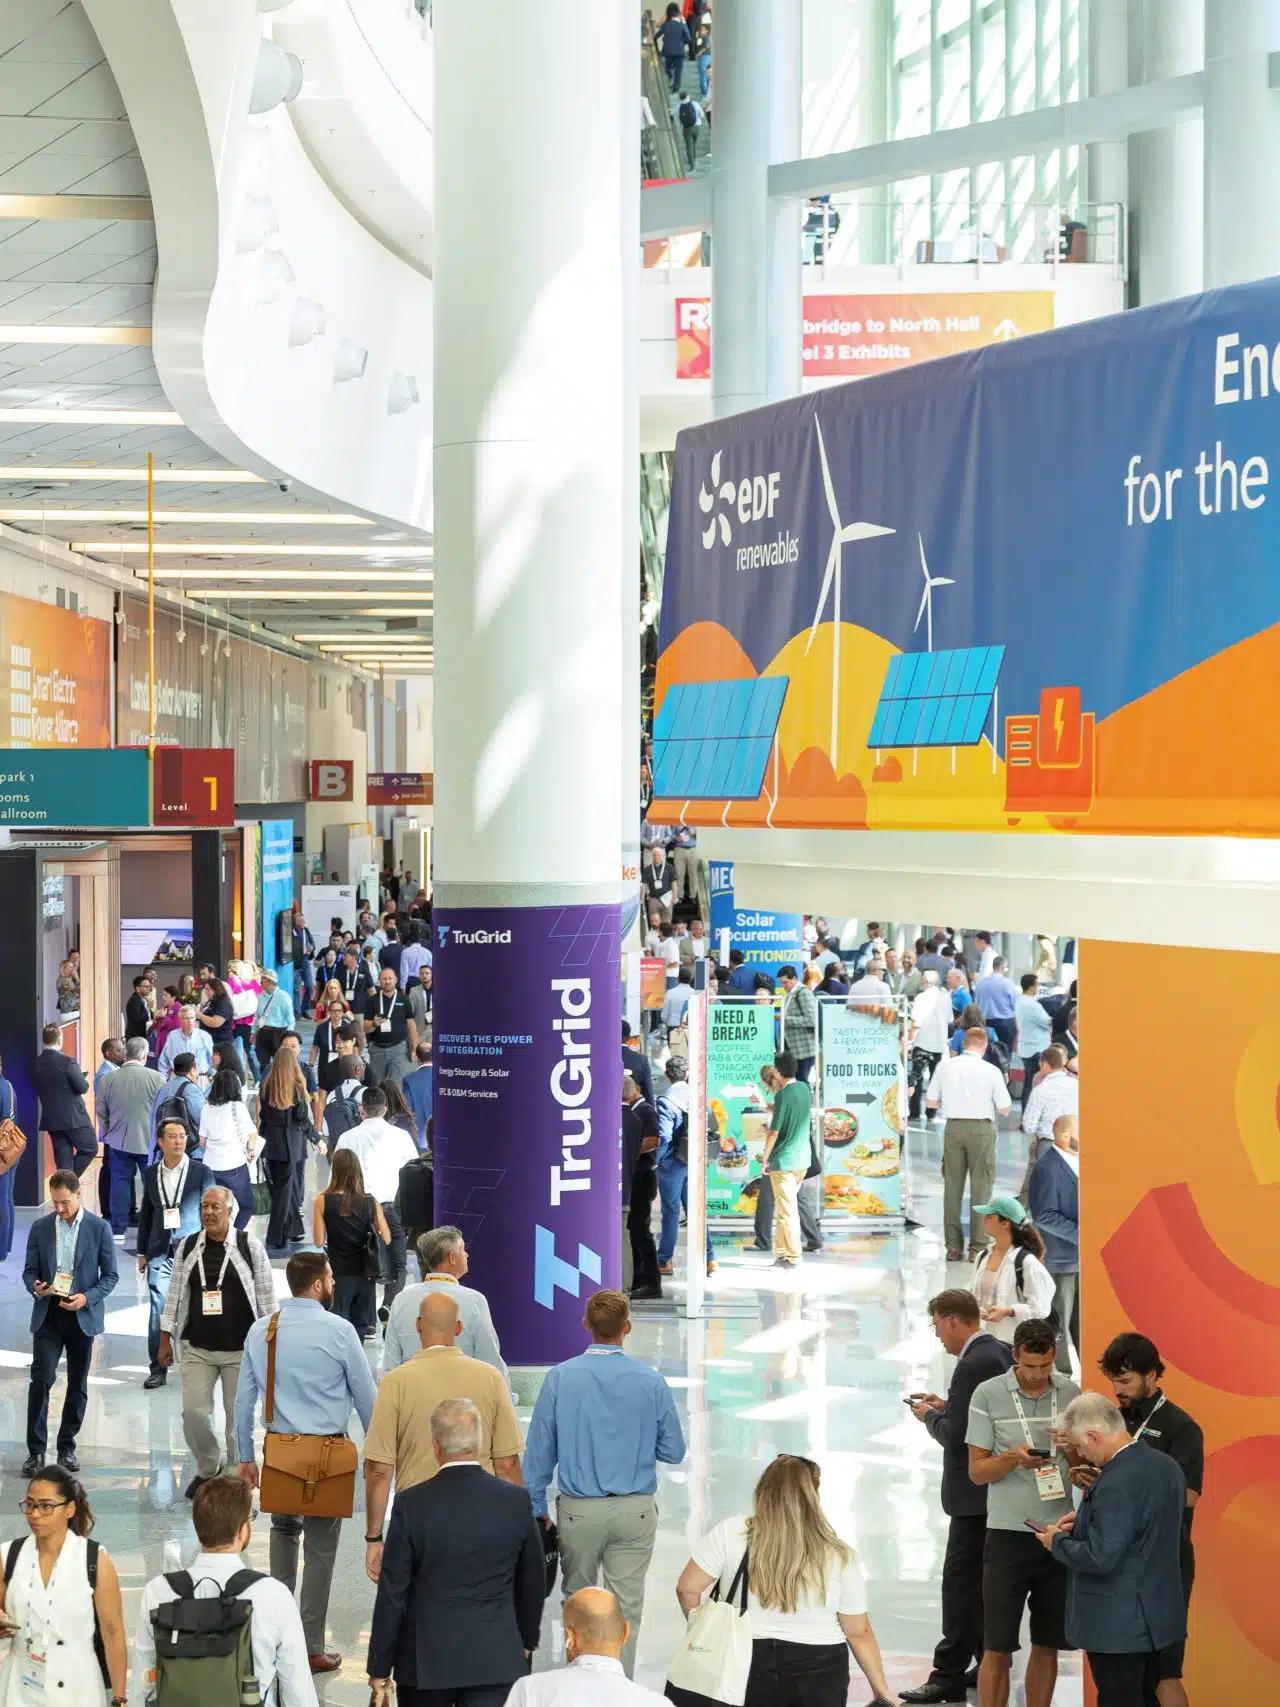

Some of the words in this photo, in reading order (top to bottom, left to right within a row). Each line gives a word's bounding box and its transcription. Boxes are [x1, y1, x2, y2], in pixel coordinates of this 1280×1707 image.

[867, 319, 885, 333] to
[889, 317, 941, 332] North
[946, 316, 980, 332] Hall
[822, 345, 835, 360] 3
[840, 344, 911, 360] Exhibits
[1124, 455, 1182, 526] for
[1195, 440, 1269, 517] the
[736, 532, 799, 571] renewables
[30, 774, 35, 782] 1
[318, 765, 347, 797] B
[203, 777, 217, 811] 1
[162, 802, 188, 811] Level
[736, 912, 775, 927] Solar
[452, 930, 512, 944] TruGrid
[715, 928, 800, 942] Pocurement,
[714, 1010, 743, 1024] NEED
[748, 1010, 755, 1024] A
[439, 1034, 471, 1043] DISCOVER
[473, 1035, 491, 1043] THE
[494, 1035, 533, 1044] POWER
[712, 1026, 758, 1040] BREAK?
[833, 1028, 860, 1036] TASTY
[446, 1046, 503, 1055] INTEGRATION
[454, 1068, 480, 1078] Storage
[481, 1069, 487, 1077] &
[488, 1069, 510, 1077] Solar
[714, 1073, 734, 1081] THIS
[736, 1073, 758, 1081] WAY
[826, 1064, 853, 1077] FOOD
[858, 1063, 897, 1077] TRUCKS
[467, 1089, 498, 1098] Services
[549, 977, 592, 1206] TruGrid
